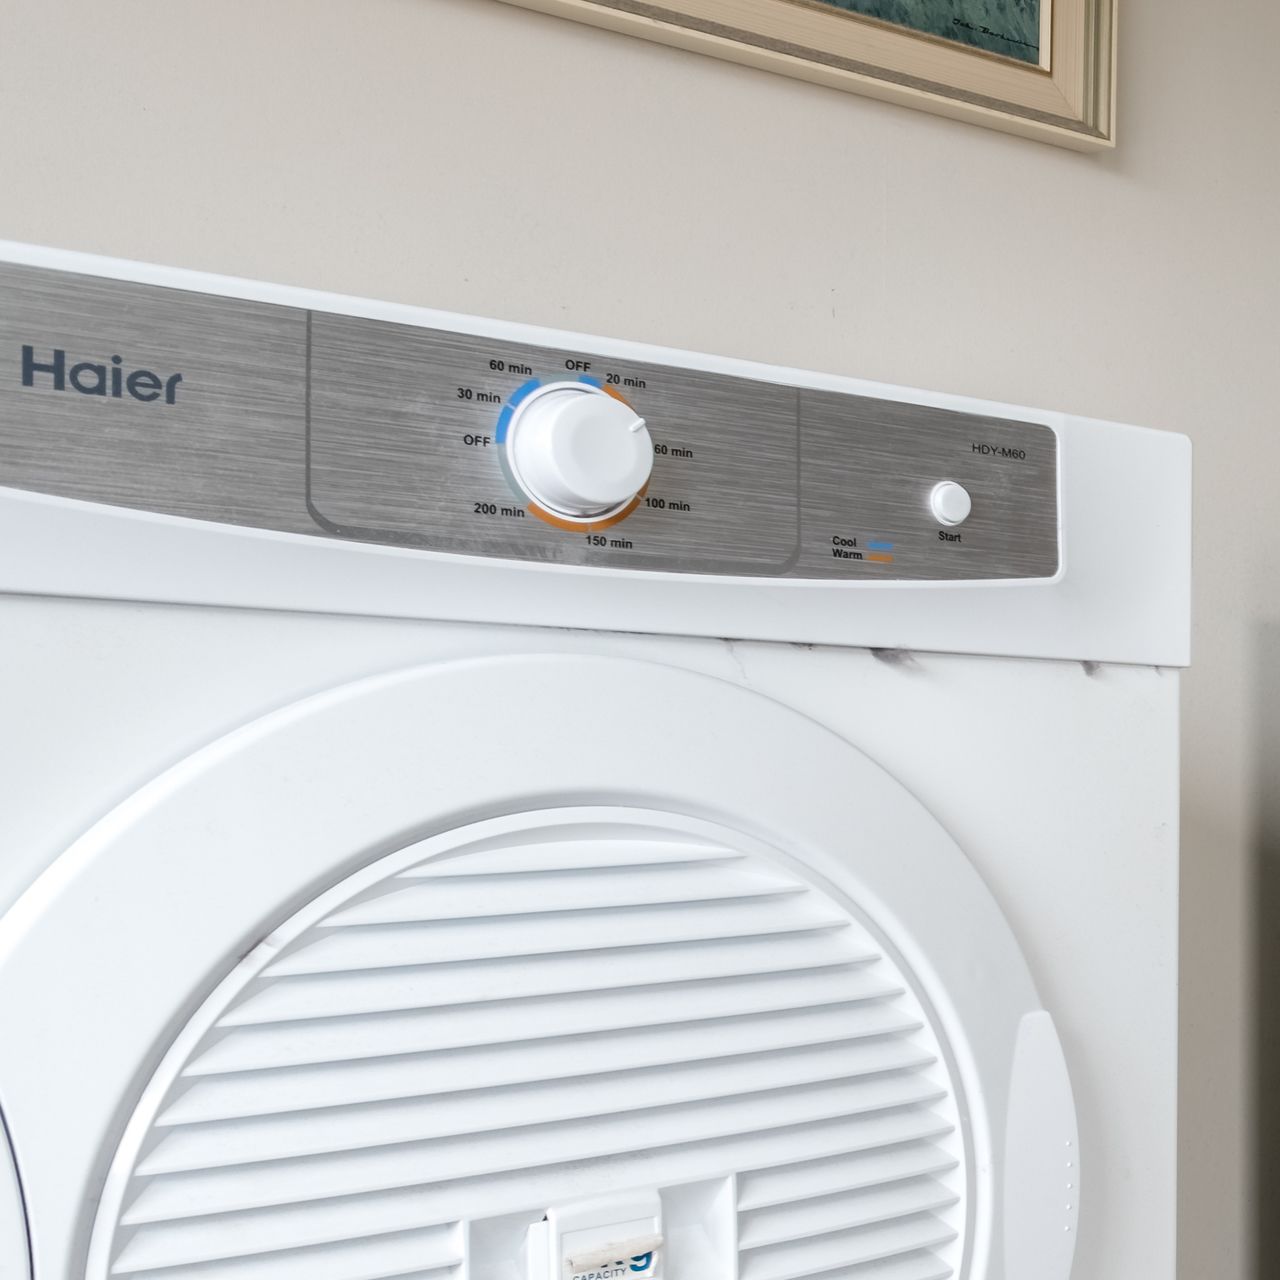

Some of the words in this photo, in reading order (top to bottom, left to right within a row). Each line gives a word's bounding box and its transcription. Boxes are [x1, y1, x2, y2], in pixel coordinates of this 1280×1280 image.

[489, 359, 505, 372] 60
[508, 362, 533, 376] min
[565, 359, 592, 373] OFF
[22, 344, 183, 405] Haier
[606, 372, 621, 385] 20
[623, 376, 647, 389] min
[457, 387, 473, 400] 30
[476, 390, 501, 404] min
[463, 434, 491, 448] OFF
[654, 444, 668, 455] 60
[671, 446, 693, 458] min
[972, 442, 1027, 460] HDY-M60
[474, 502, 498, 515] 200
[501, 505, 525, 518] min
[645, 497, 666, 510] 100
[668, 500, 690, 512] min
[585, 535, 607, 548] 150
[610, 537, 633, 550] min
[832, 535, 857, 548] Cool
[938, 530, 962, 543] Start
[831, 548, 863, 560] Warm
